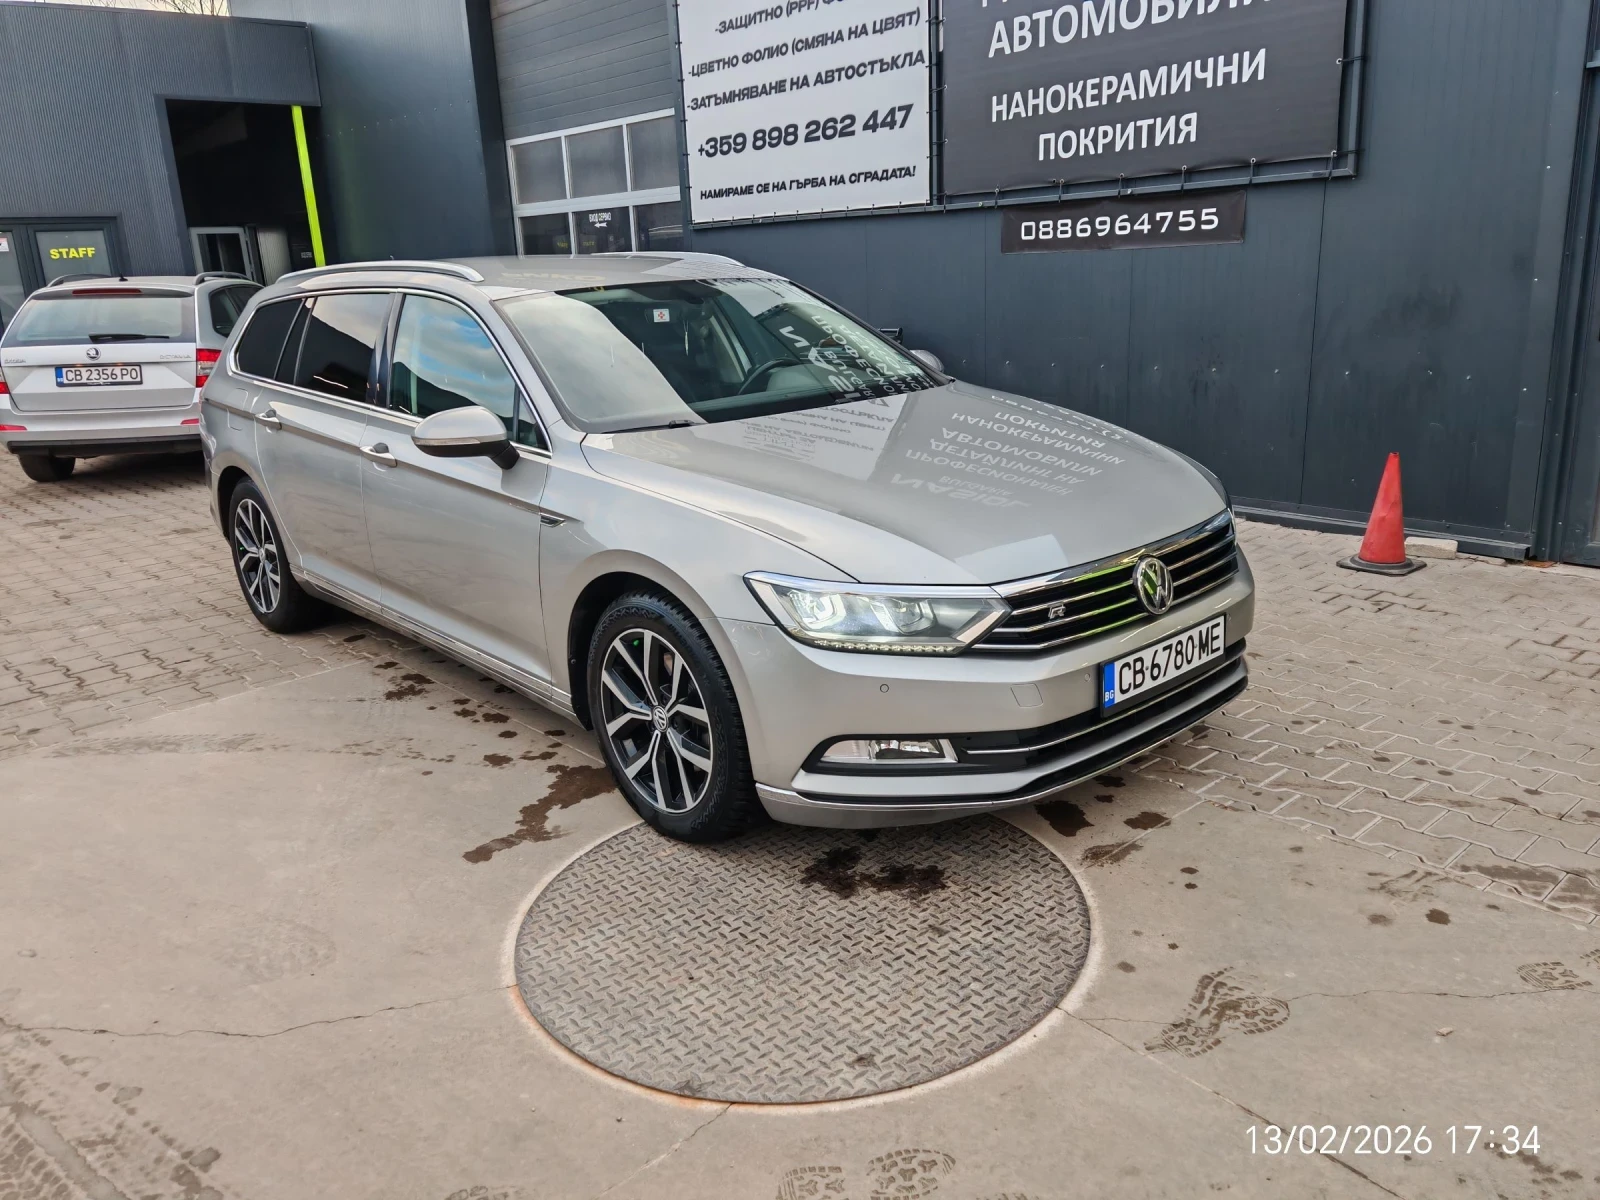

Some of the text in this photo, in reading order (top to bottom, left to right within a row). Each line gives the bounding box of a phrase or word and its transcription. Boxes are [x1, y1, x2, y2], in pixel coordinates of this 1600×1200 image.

[688, 6, 921, 78] -ЦВЕТНО ФОЛИО (СМЯНА НА ЦВЯТ)
[715, 5, 783, 34] -ЗАЩИТНО
[988, 0, 1271, 58] АВТОМОБ
[687, 49, 926, 111] -ЗАТЪМНЯВАНЕ НА АВТОСТЪКЛА
[991, 47, 1266, 123] НАНОКЕРАМИЧНИ
[698, 103, 914, 158] +359 898 262 447
[1038, 111, 1198, 161] ПОКРИТИЯ
[700, 165, 917, 200] НАМИРАМЕ СЕ НА ГЪРБА НА СГРАДАТА!
[1020, 207, 1220, 241] 0886964755
[49, 247, 96, 260] STAFF
[65, 369, 83, 382] CB
[85, 368, 118, 381] 2356
[120, 368, 139, 381] PO
[1104, 622, 1221, 702] BG CB 6780 ME
